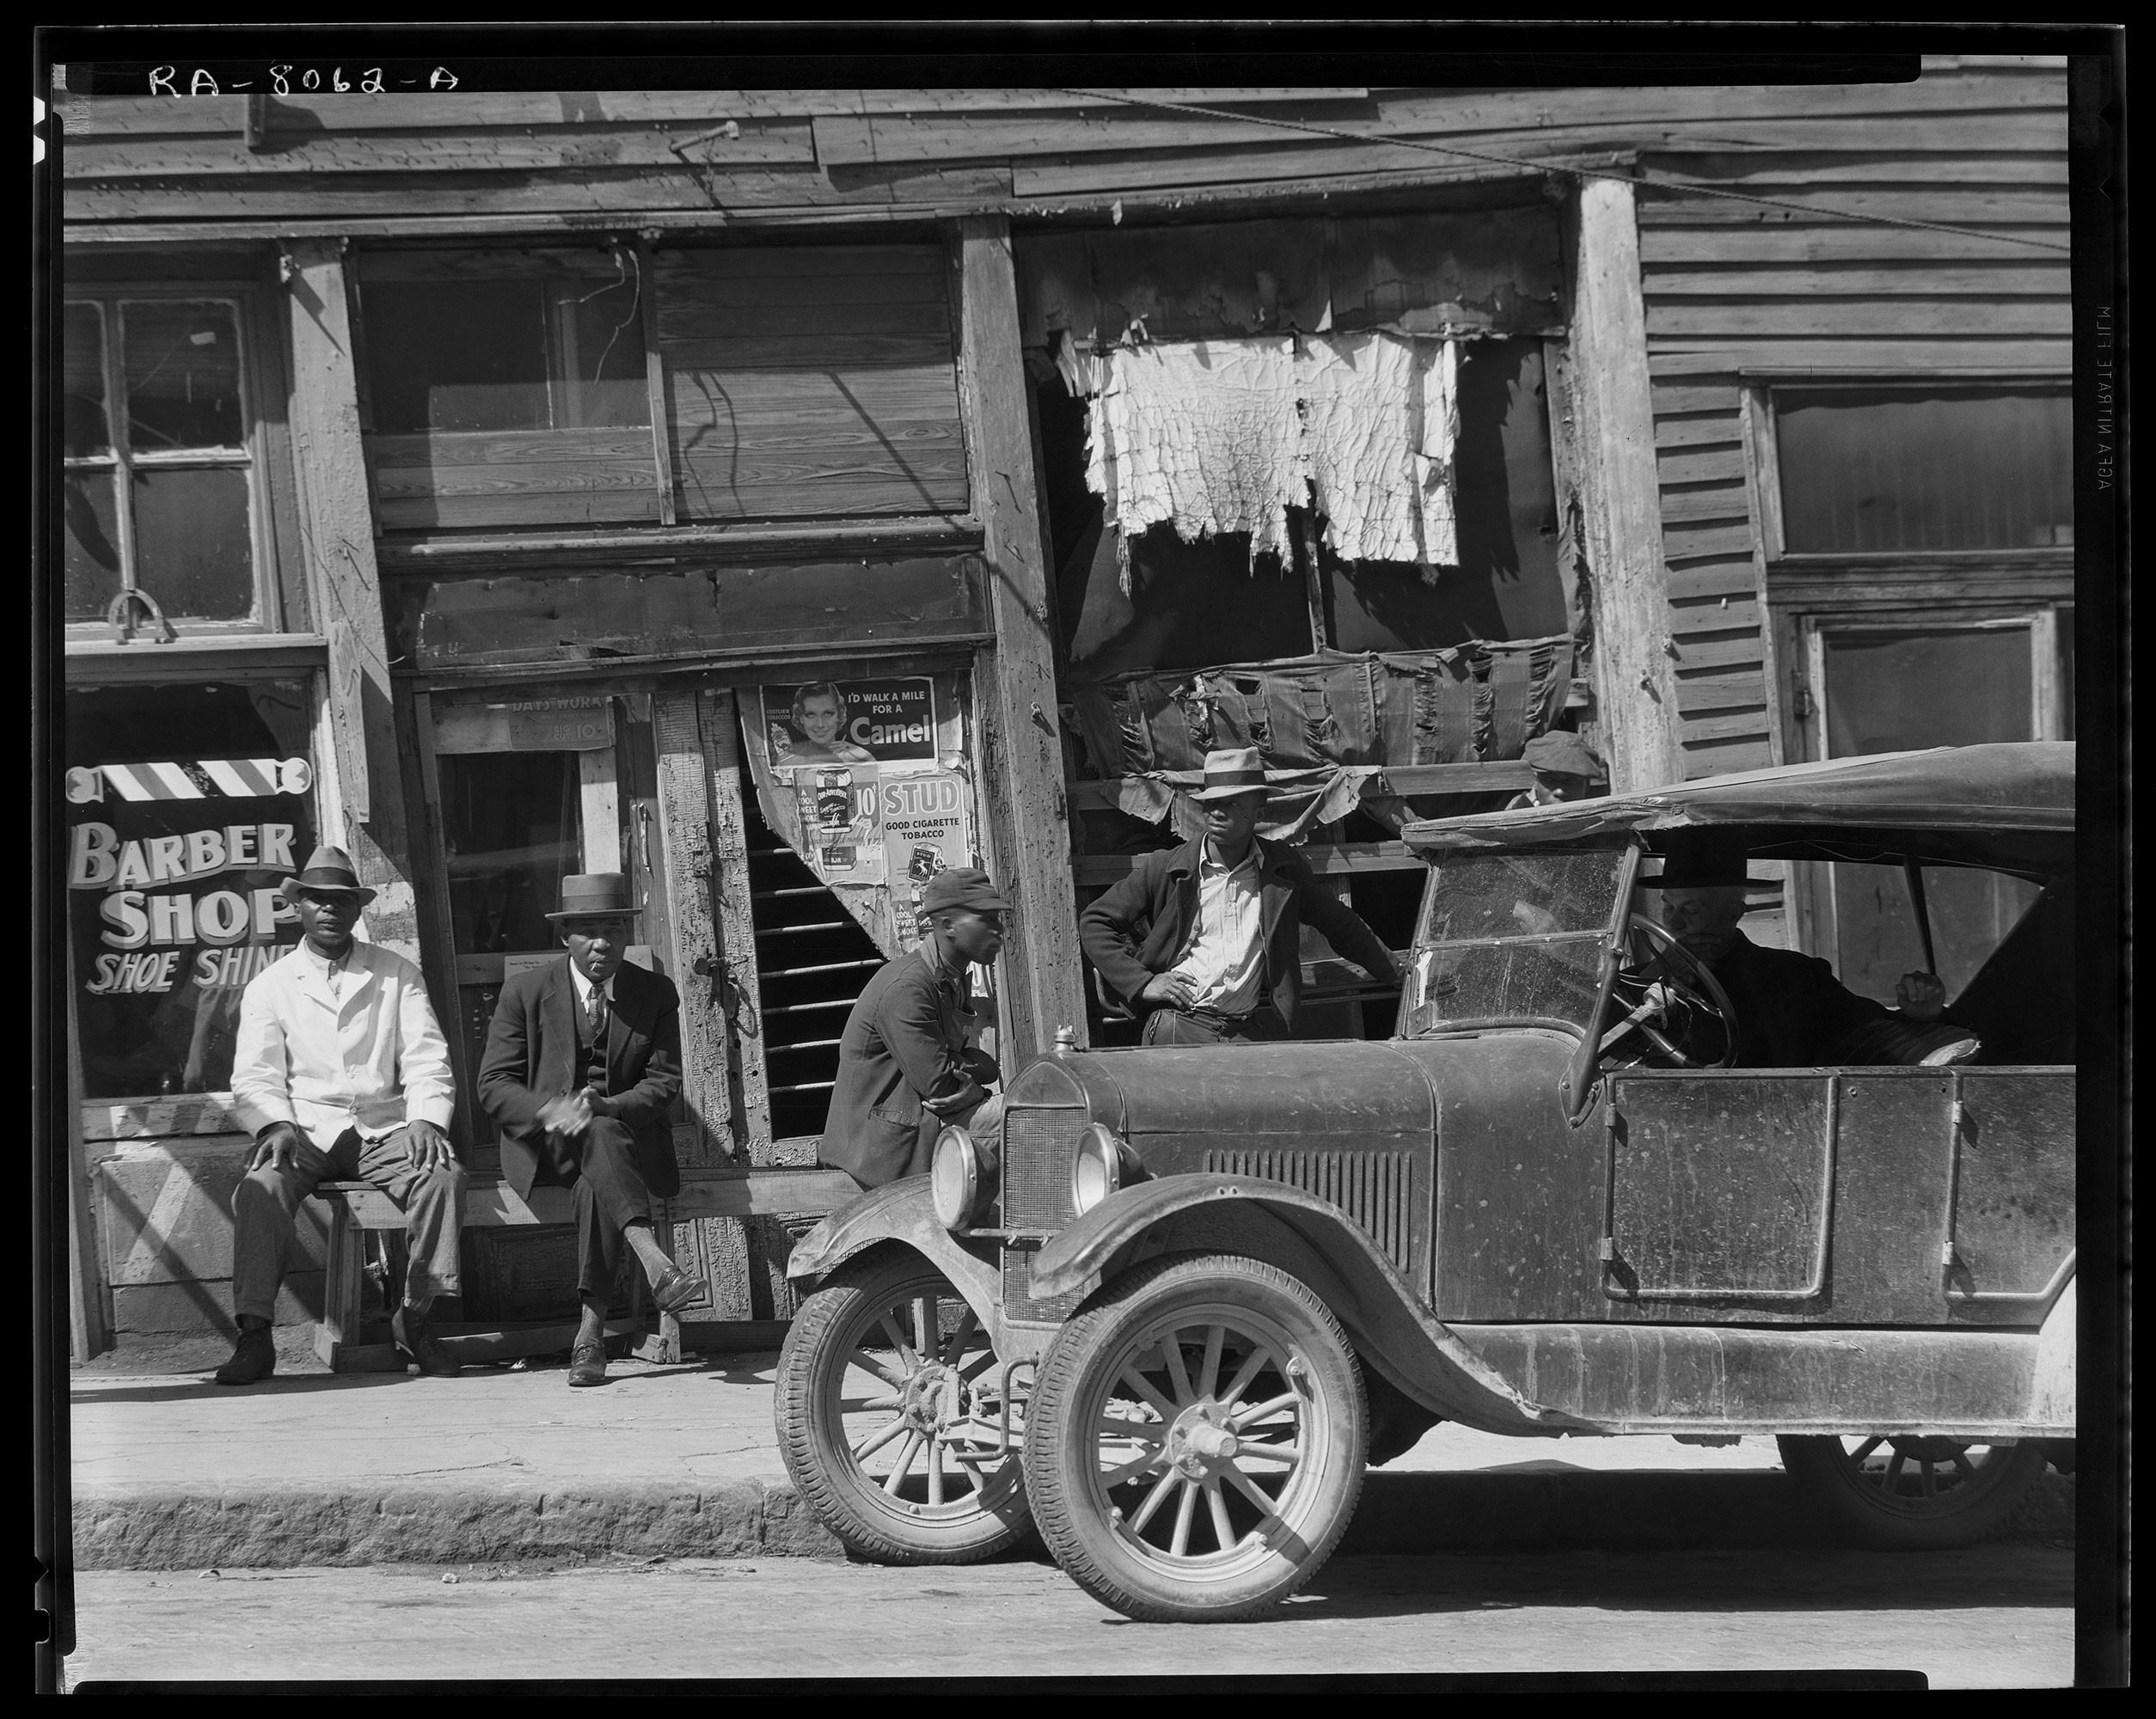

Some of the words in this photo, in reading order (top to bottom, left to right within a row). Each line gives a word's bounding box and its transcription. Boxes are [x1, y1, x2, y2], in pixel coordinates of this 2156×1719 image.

[555, 696, 604, 710] WORK
[848, 692, 861, 703] I'D
[862, 693, 890, 702] WALK
[891, 692, 898, 701] A
[901, 690, 925, 700] MILE
[873, 705, 892, 714] FOR
[895, 704, 903, 713] A
[553, 725, 570, 733] BIG
[849, 713, 930, 745] Camel
[883, 780, 959, 816] STUD
[885, 821, 910, 830] GOOD
[912, 817, 959, 829] CIGARETTE
[901, 829, 945, 840] TOBACCO
[67, 822, 297, 892] BARBER
[100, 888, 301, 950] SHOP
[86, 951, 181, 994] SHOE
